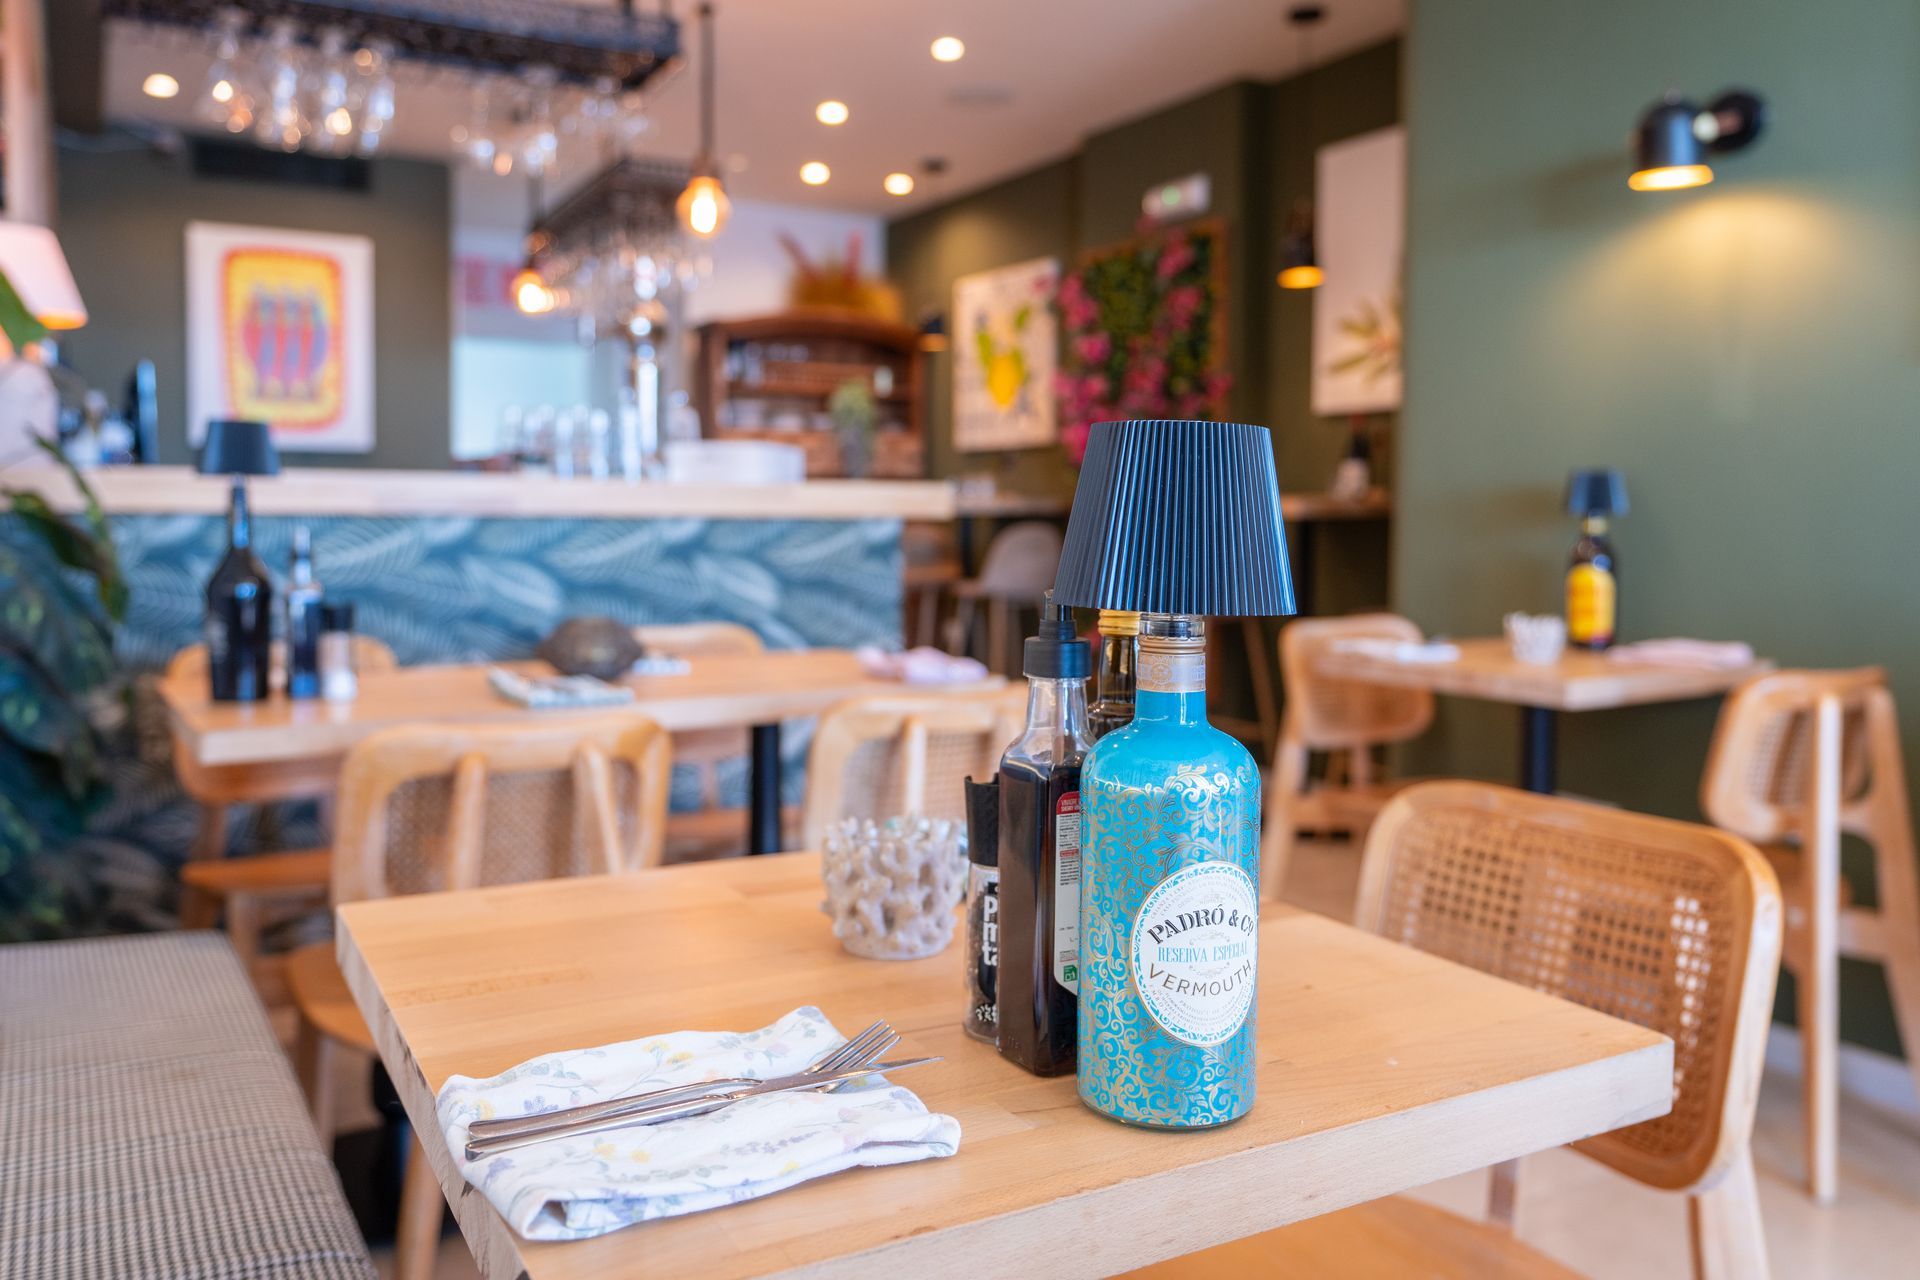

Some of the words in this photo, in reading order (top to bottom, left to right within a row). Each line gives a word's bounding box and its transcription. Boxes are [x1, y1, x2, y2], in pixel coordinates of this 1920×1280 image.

[1147, 904, 1225, 944] PADRÓ
[1228, 909, 1240, 927] &
[1158, 946, 1208, 963] RESERVA
[1213, 940, 1249, 961] ESPECIAL
[1150, 959, 1252, 997] VERMOUTH
